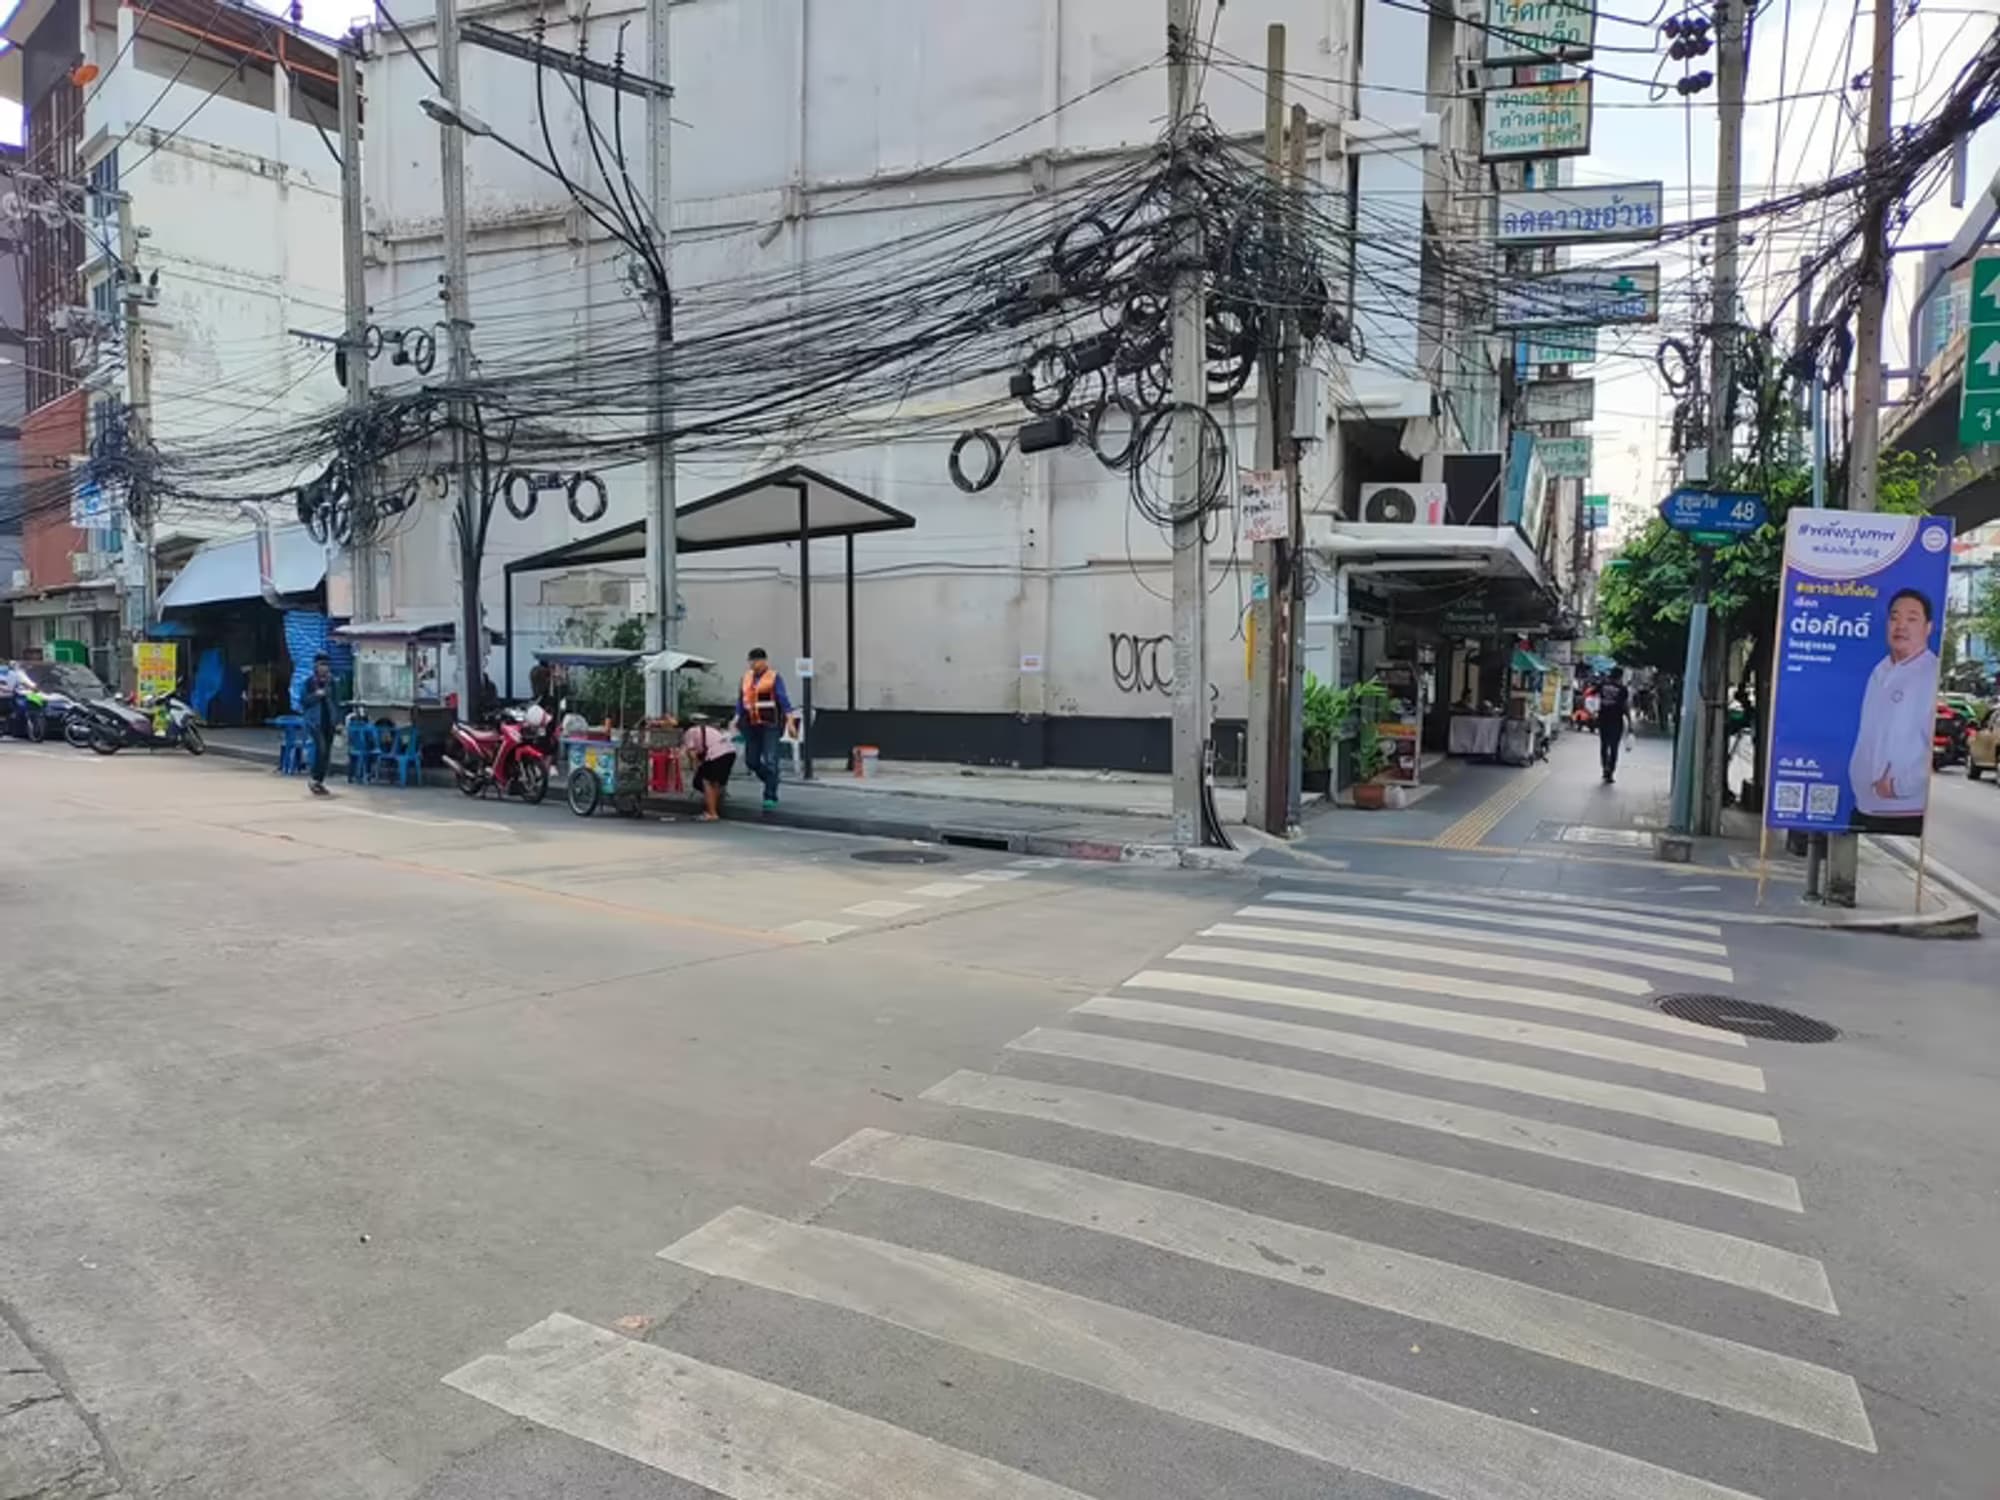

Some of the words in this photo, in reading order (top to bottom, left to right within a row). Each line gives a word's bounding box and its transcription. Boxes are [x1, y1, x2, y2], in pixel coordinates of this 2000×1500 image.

[1503, 194, 1654, 233] ลดความอ้วน
[1730, 499, 1756, 521] 48
[1790, 611, 1872, 638] ต่อศักดิ์
